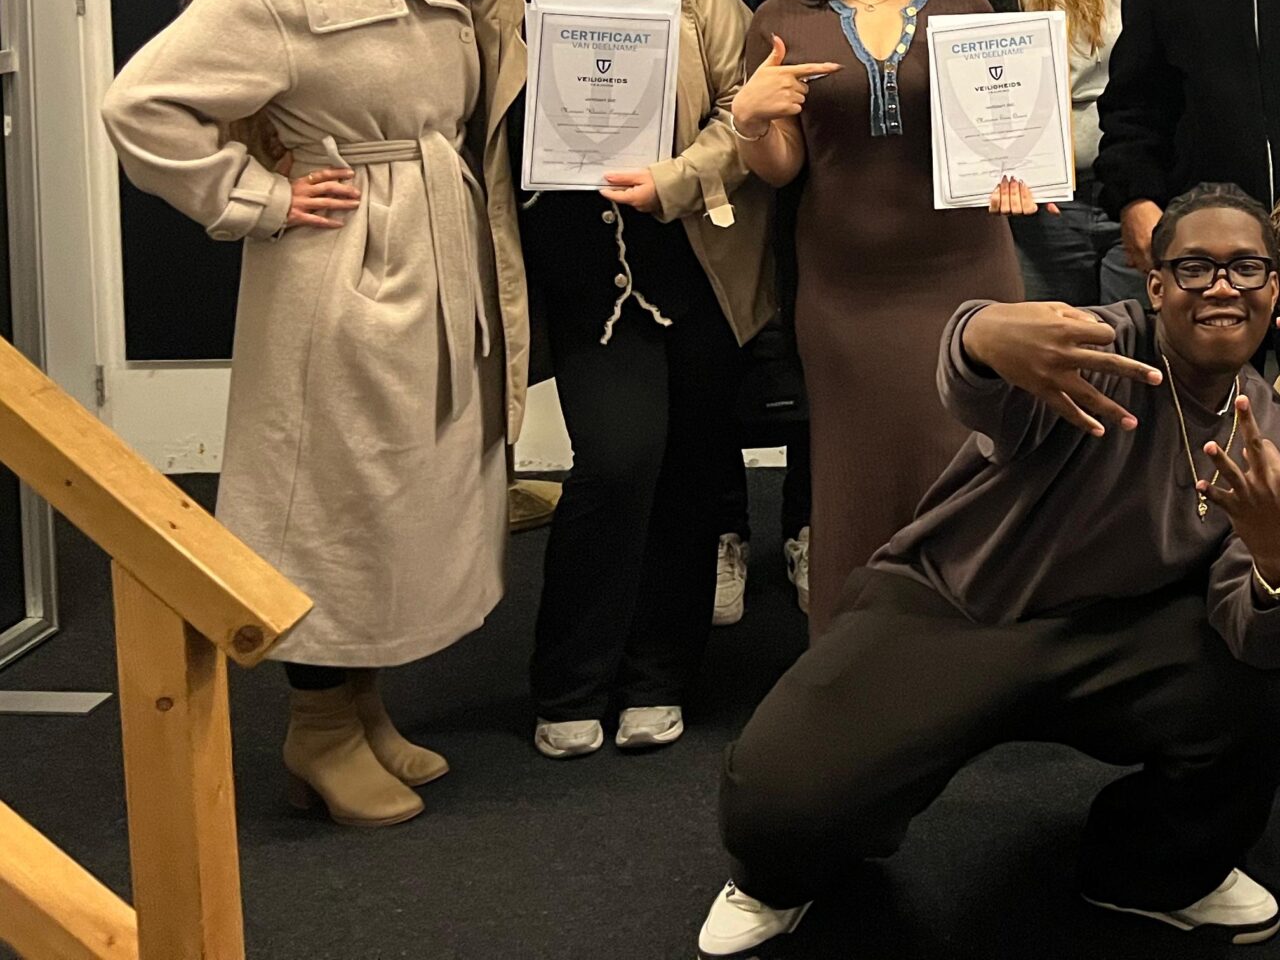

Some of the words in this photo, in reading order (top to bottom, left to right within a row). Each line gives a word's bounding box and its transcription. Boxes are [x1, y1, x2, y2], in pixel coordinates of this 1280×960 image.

[560, 29, 651, 44] CERTIFICAAT
[572, 42, 591, 50] VAN
[592, 43, 638, 52] DEELNAME
[951, 34, 1034, 54] CERTIFICAAT
[964, 52, 981, 61] VAN
[981, 48, 1025, 59] DEELNAME
